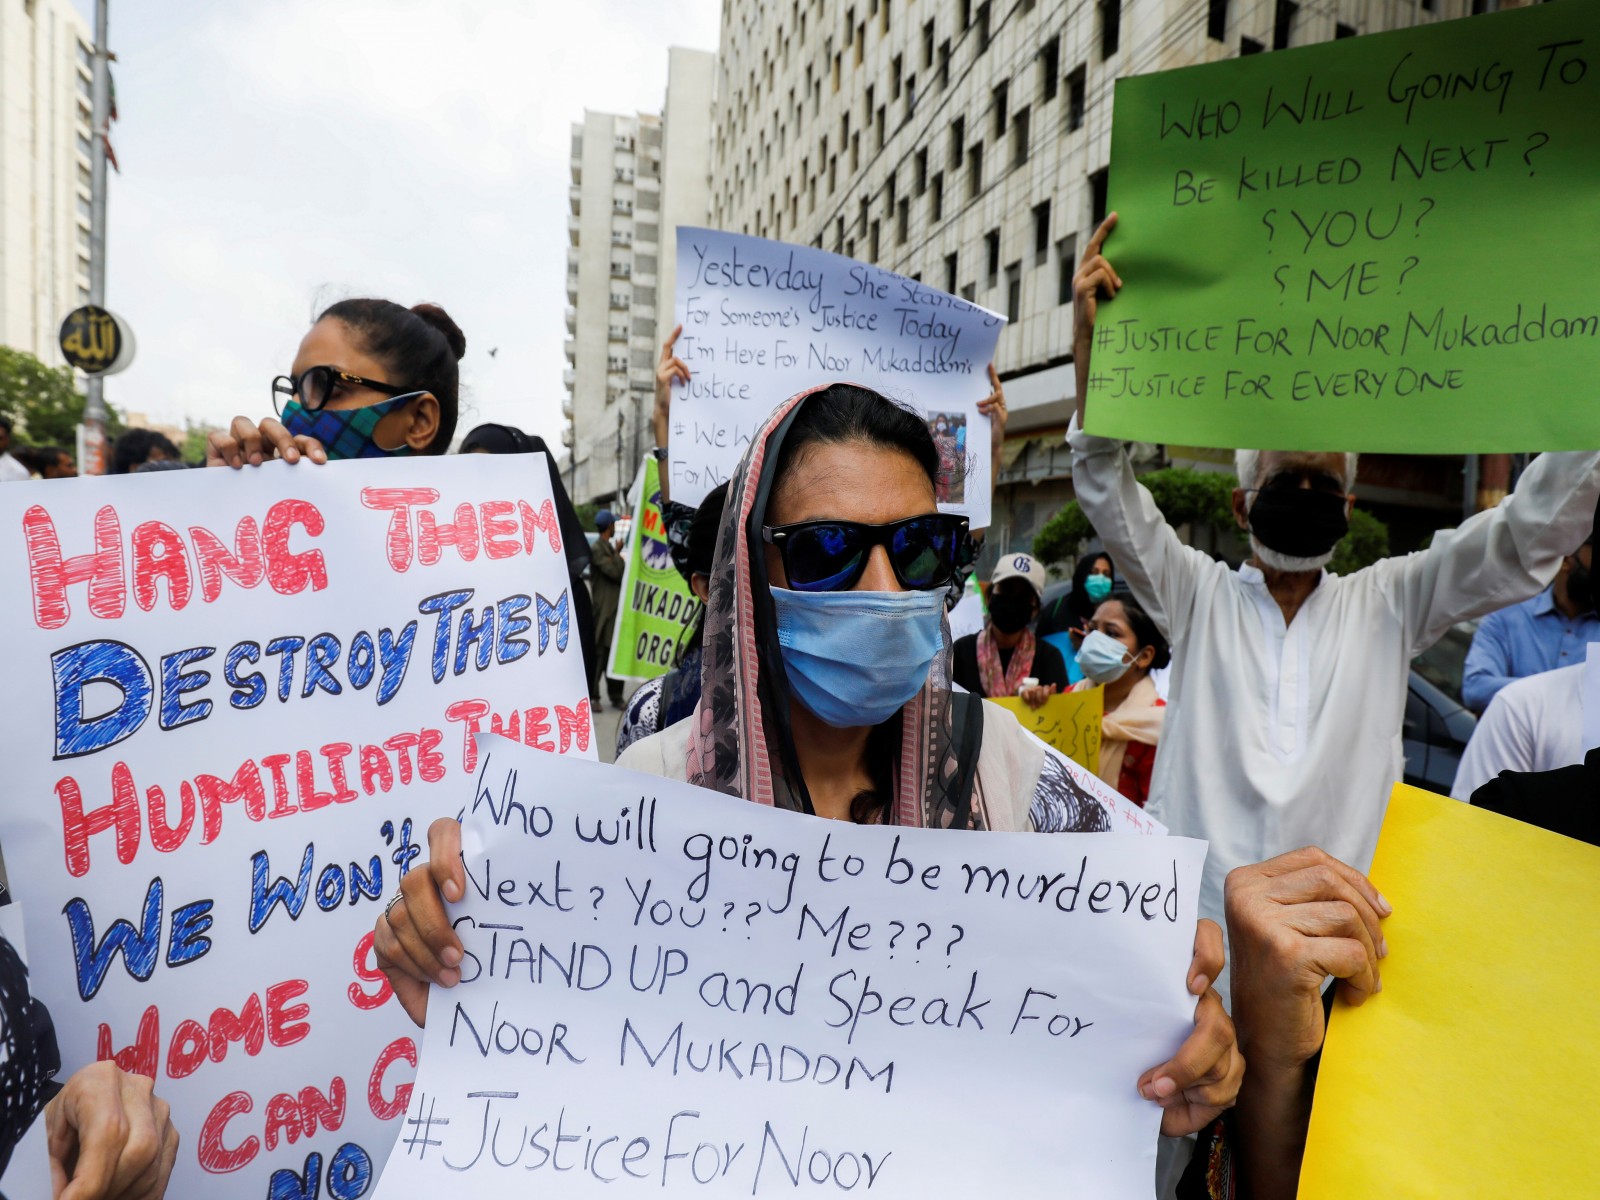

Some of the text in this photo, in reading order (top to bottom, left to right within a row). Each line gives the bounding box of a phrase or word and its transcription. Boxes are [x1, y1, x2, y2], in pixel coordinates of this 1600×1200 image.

[1159, 39, 1588, 141] WHO WILL GOING TO
[1173, 169, 1219, 207] BE
[1237, 156, 1362, 201] KILLED
[687, 243, 823, 315] Yesterday
[844, 265, 889, 300] She
[685, 297, 961, 361] For Someone's Justice Today
[724, 342, 766, 367] Here
[774, 340, 800, 369] For
[807, 342, 853, 373] Noor
[1096, 303, 1599, 357] #JUSTICE FOR NOOR Mukaddam
[679, 371, 751, 402] Justice
[1089, 366, 1206, 400] #JUSTICE
[1224, 370, 1275, 401] FOR
[673, 461, 699, 487] For
[23, 486, 562, 630] HANG THEM
[50, 587, 570, 762] DESTROY THEM
[54, 727, 445, 878] HUMILIATE
[471, 752, 1179, 923] Who will going to be murdered
[62, 876, 214, 1002] WE
[452, 914, 612, 992] STAND
[629, 943, 689, 996] UP
[698, 962, 804, 1016] and
[823, 968, 992, 1045] Speak
[1009, 986, 1095, 1038] For
[97, 978, 310, 1080] HOME
[449, 1000, 588, 1066] NOOR
[198, 1076, 347, 1174] CAN
